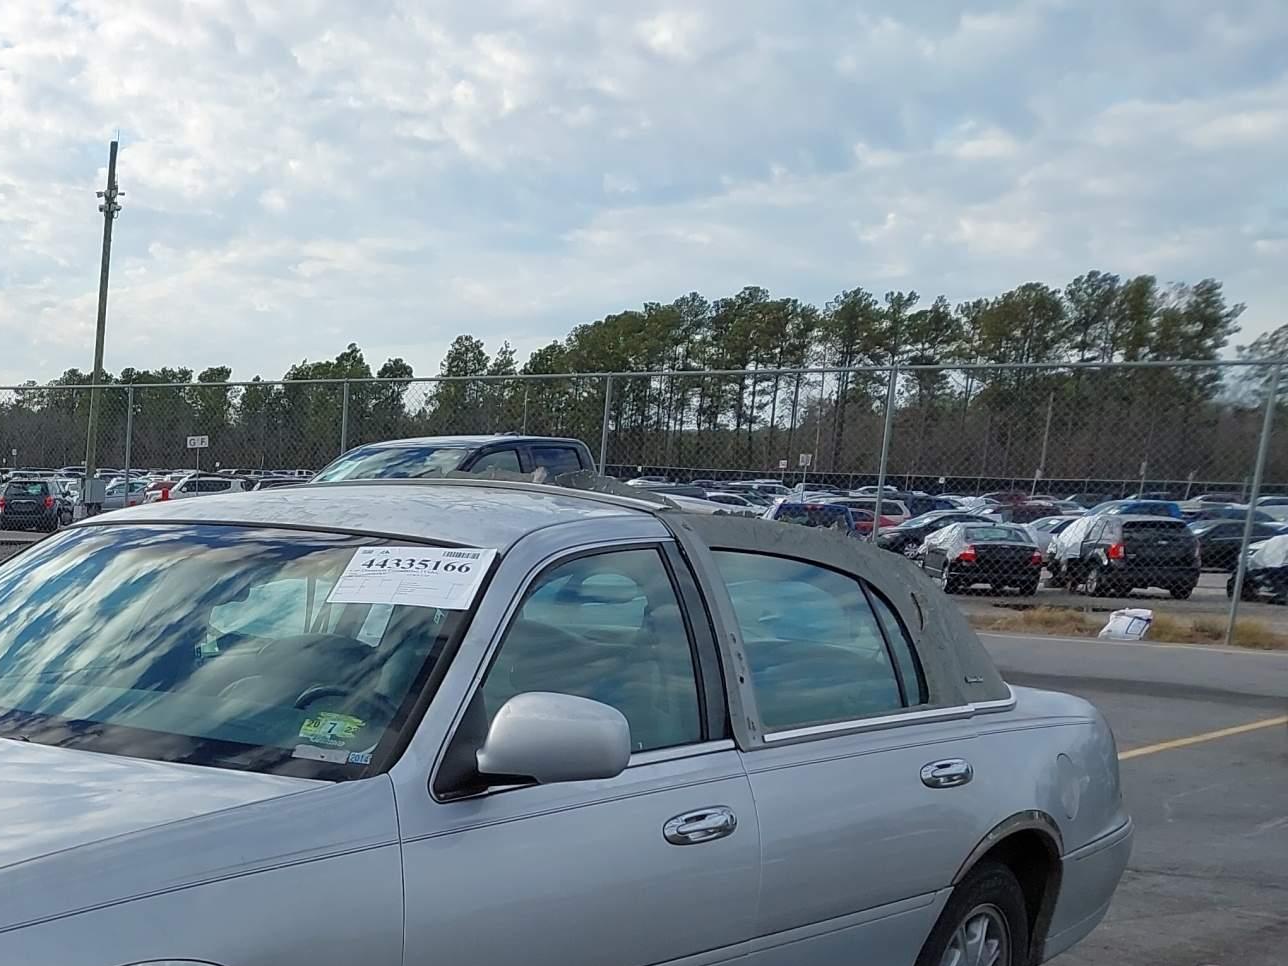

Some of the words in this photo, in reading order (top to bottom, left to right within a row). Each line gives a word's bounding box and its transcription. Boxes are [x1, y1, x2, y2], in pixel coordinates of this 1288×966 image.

[189, 438, 196, 447] G
[361, 558, 473, 573] 44335166
[327, 722, 337, 734] 7
